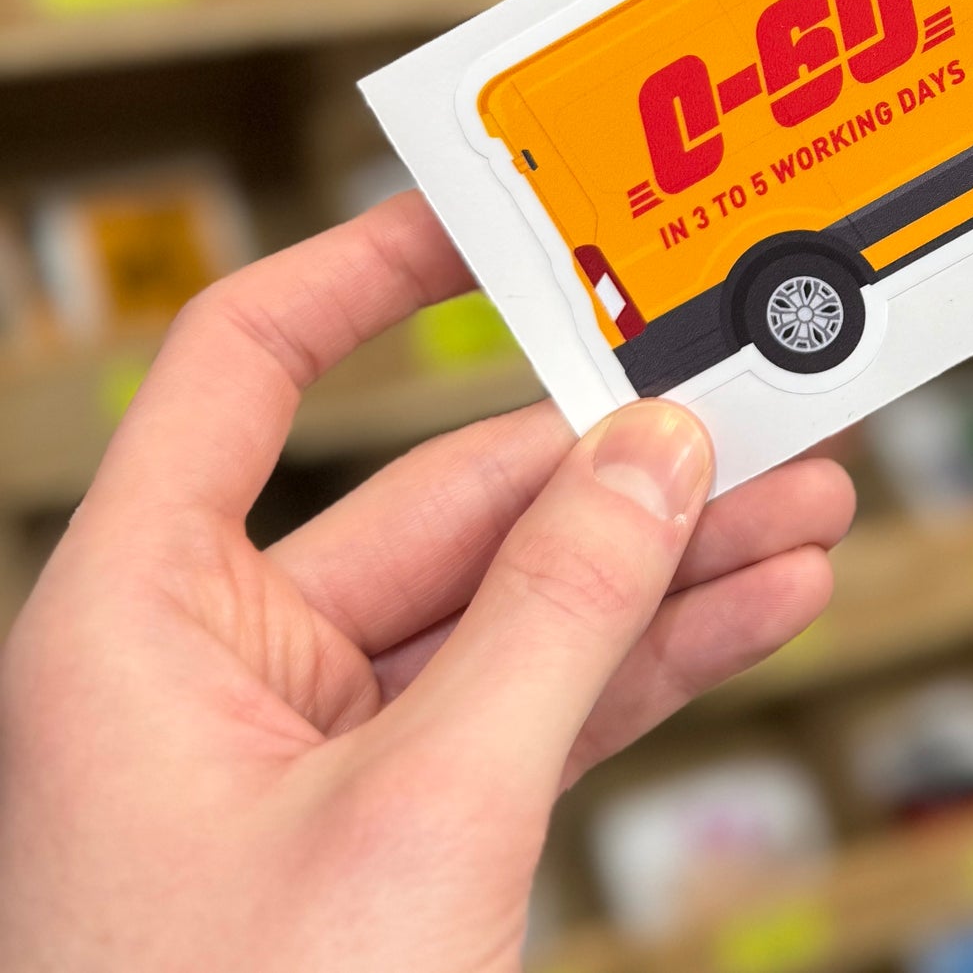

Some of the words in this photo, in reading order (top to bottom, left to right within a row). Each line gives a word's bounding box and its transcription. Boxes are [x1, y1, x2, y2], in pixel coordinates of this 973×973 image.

[658, 215, 691, 251] IN
[691, 205, 711, 231] 3
[709, 183, 748, 219] TO
[749, 170, 770, 197] 5
[768, 100, 894, 185] WORKING
[895, 58, 967, 116] DAYS
